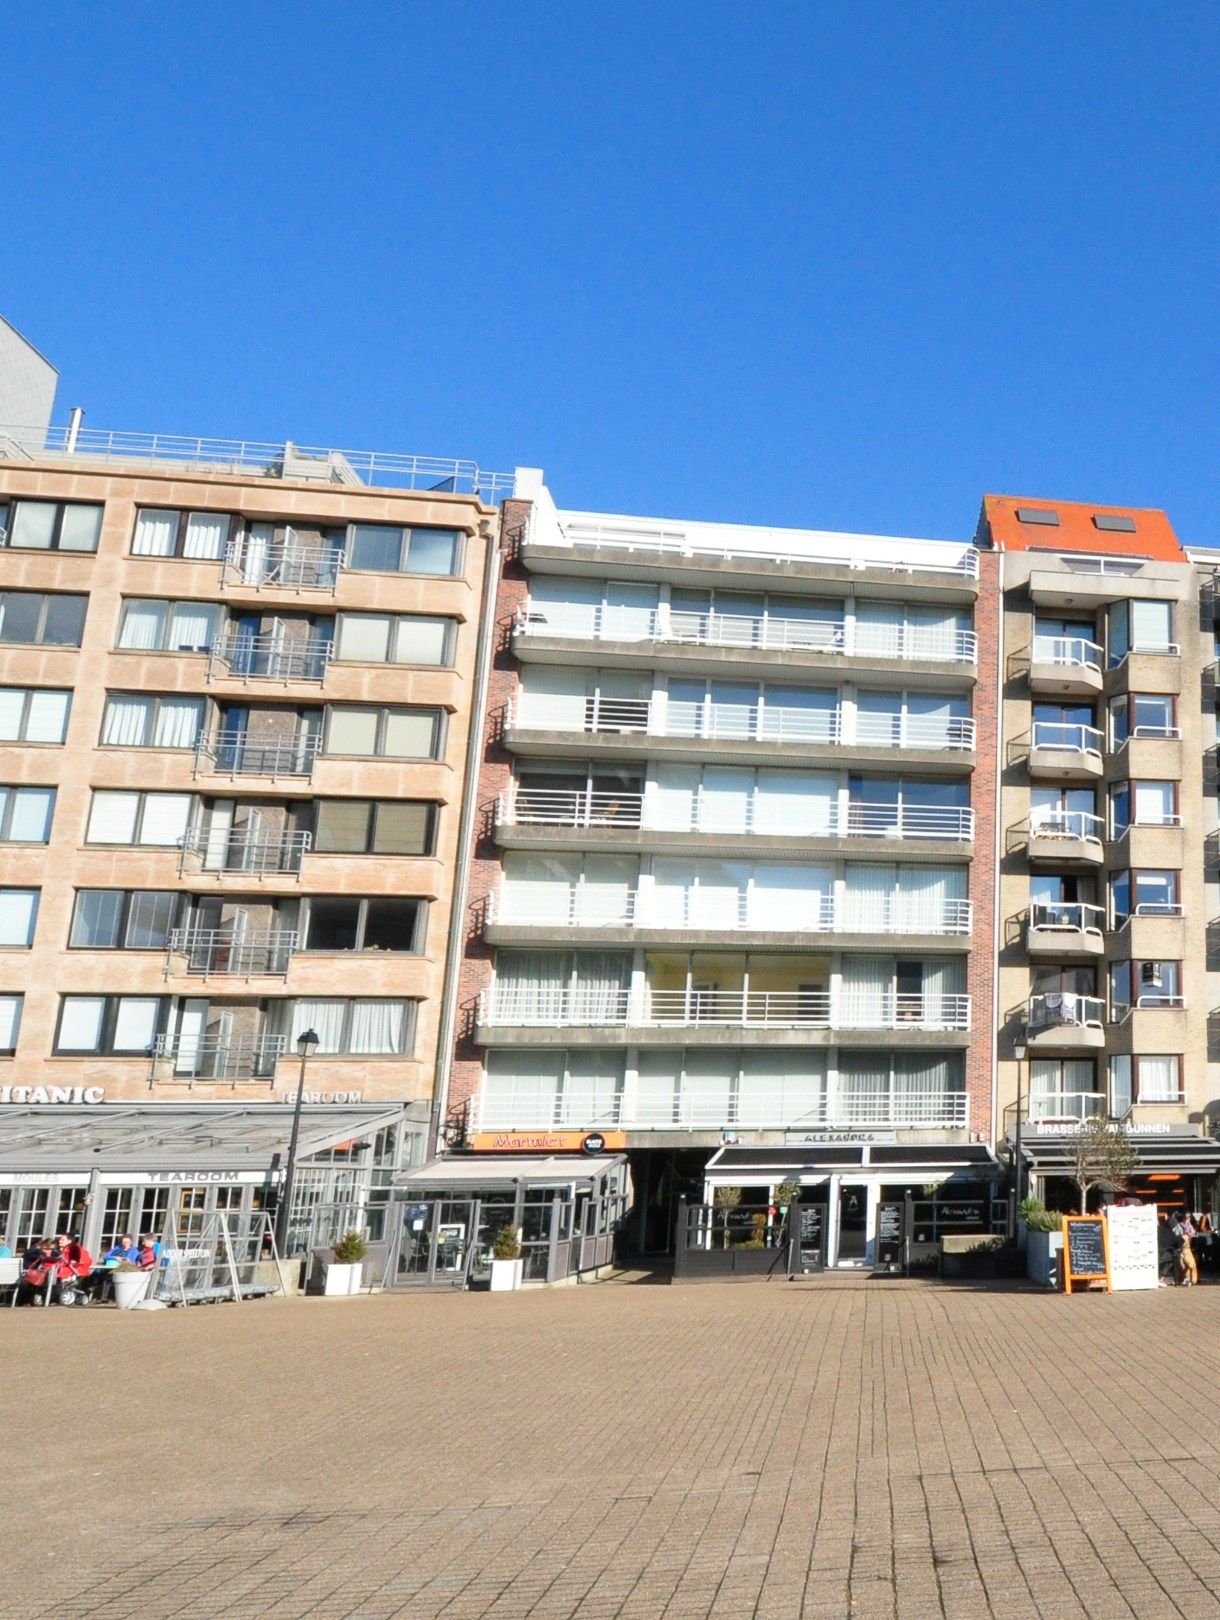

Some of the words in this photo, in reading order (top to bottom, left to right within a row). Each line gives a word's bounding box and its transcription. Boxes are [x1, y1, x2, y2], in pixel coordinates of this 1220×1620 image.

[0, 1086, 105, 1104] ITANIC
[1036, 1124, 1098, 1134] BRASSEI
[148, 1171, 239, 1182] TEAROOM
